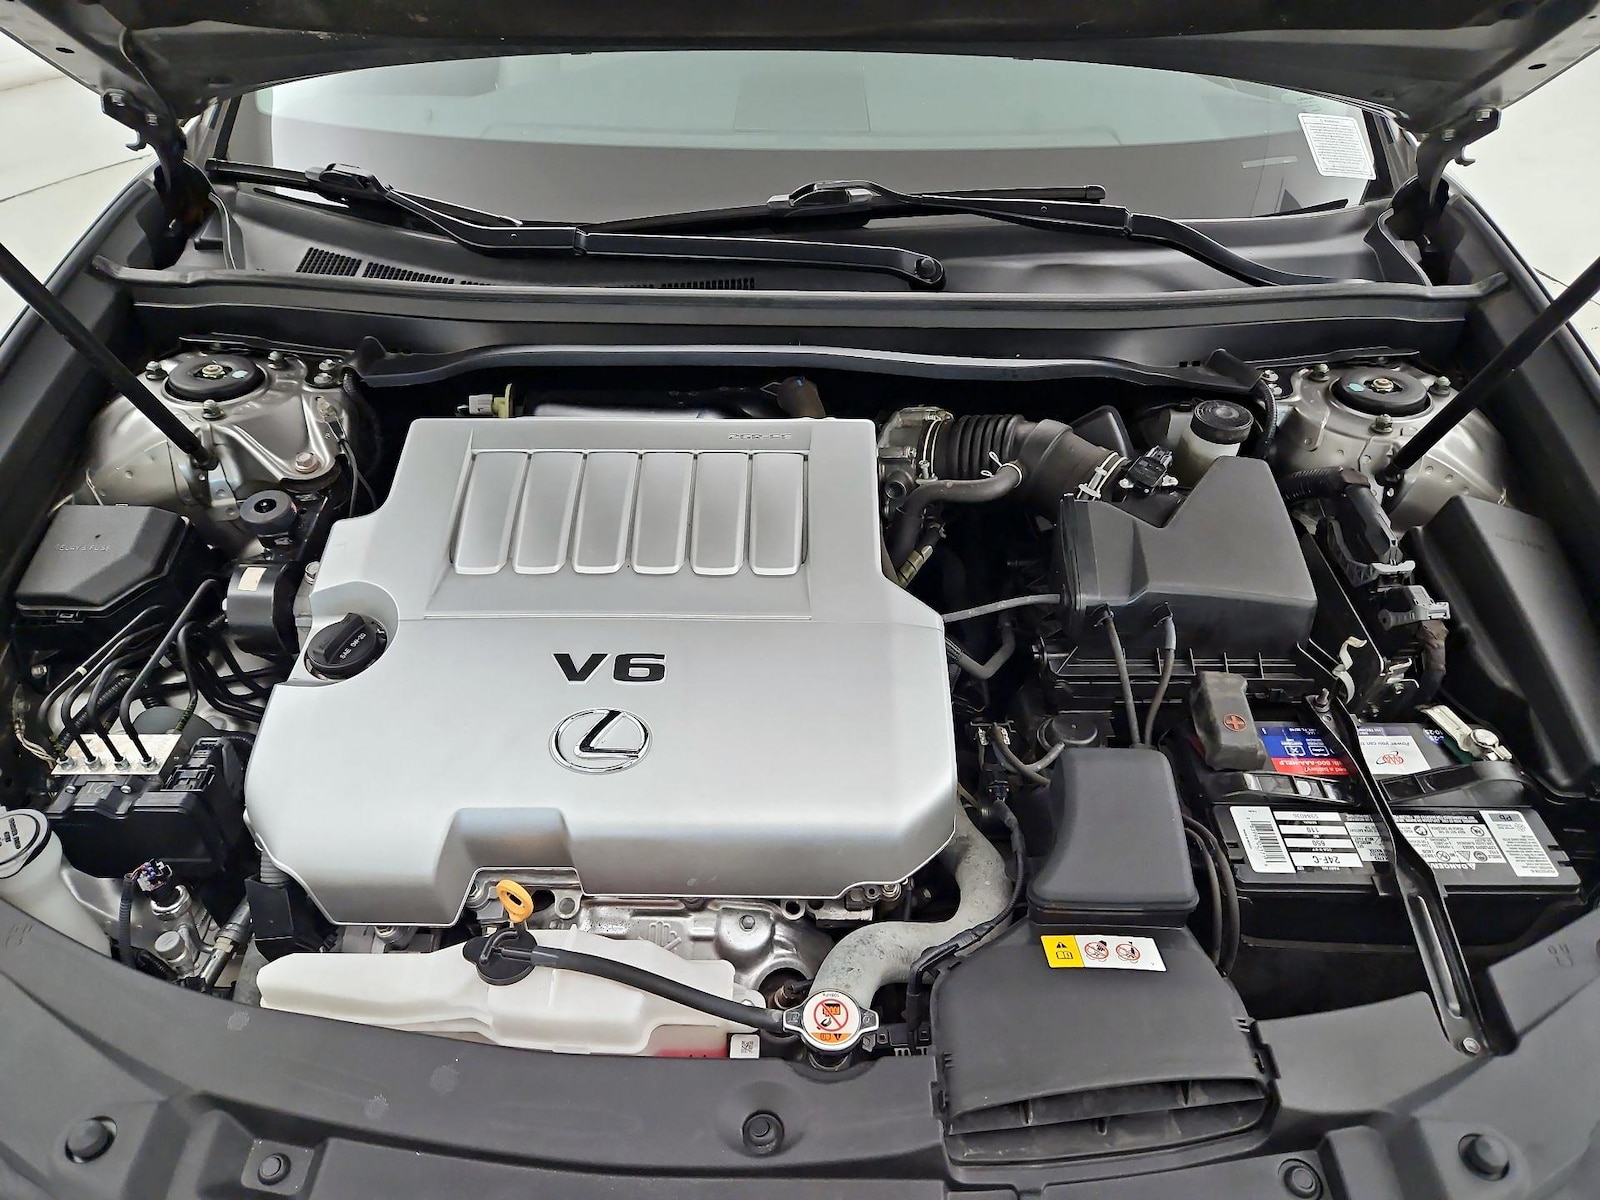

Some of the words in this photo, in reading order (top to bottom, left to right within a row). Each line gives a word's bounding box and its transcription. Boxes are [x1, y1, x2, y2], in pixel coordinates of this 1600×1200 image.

[339, 648, 352, 659] SAE
[552, 652, 666, 684] V6
[1312, 856, 1340, 864] 24F-C
